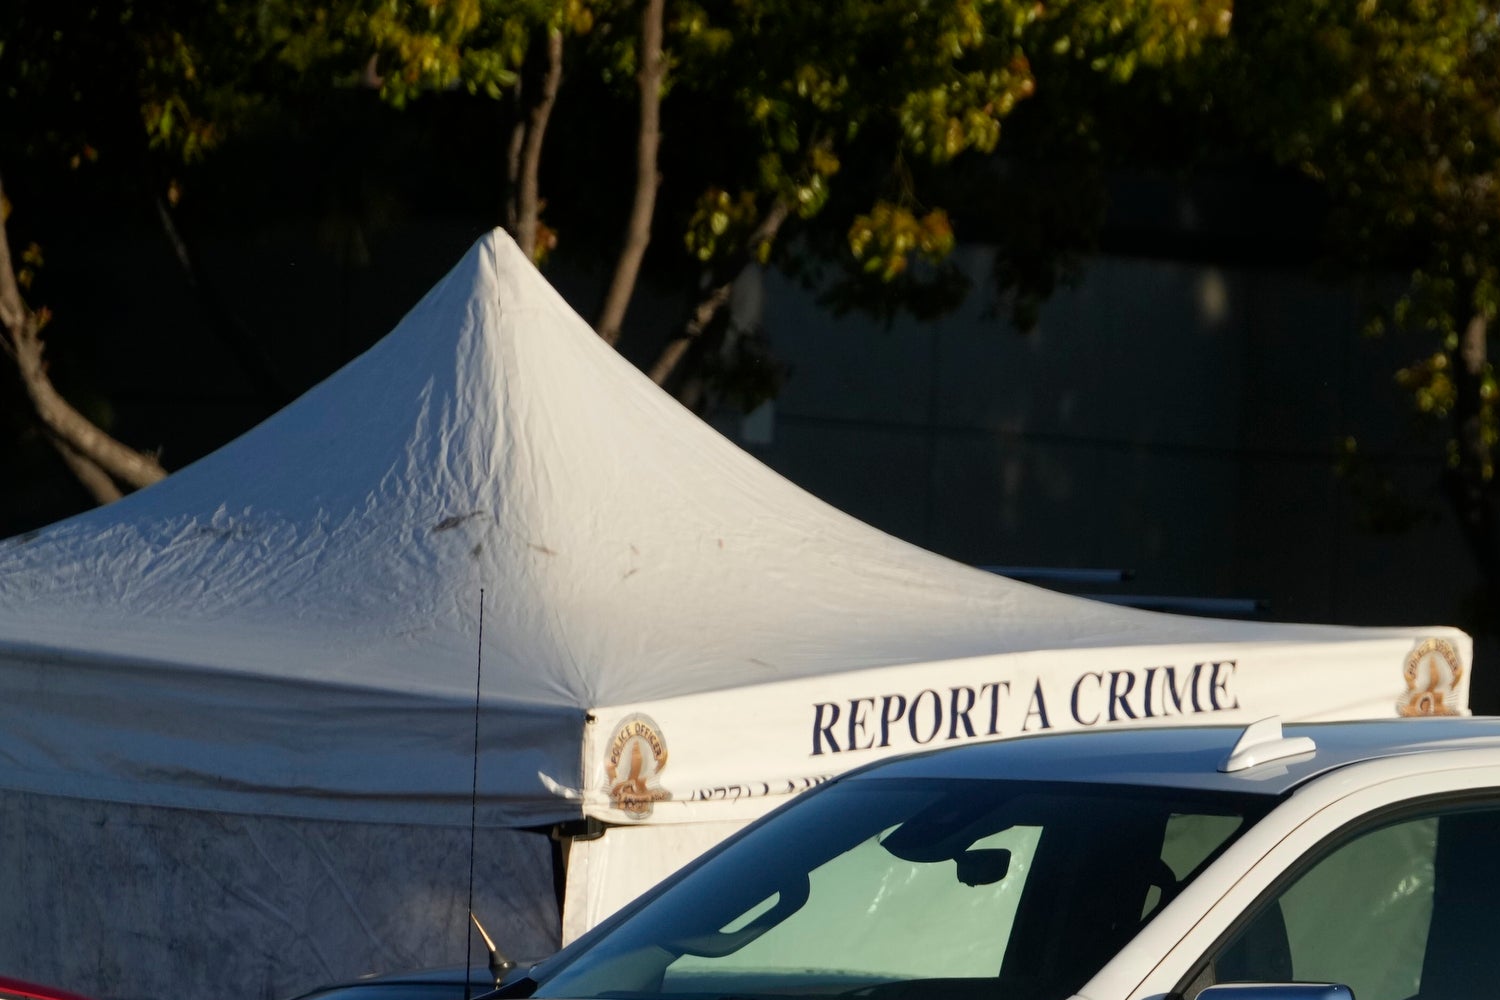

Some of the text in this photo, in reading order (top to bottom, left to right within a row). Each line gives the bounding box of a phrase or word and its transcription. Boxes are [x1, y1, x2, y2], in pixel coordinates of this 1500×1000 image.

[809, 660, 1240, 757] REPORT A CRIME
